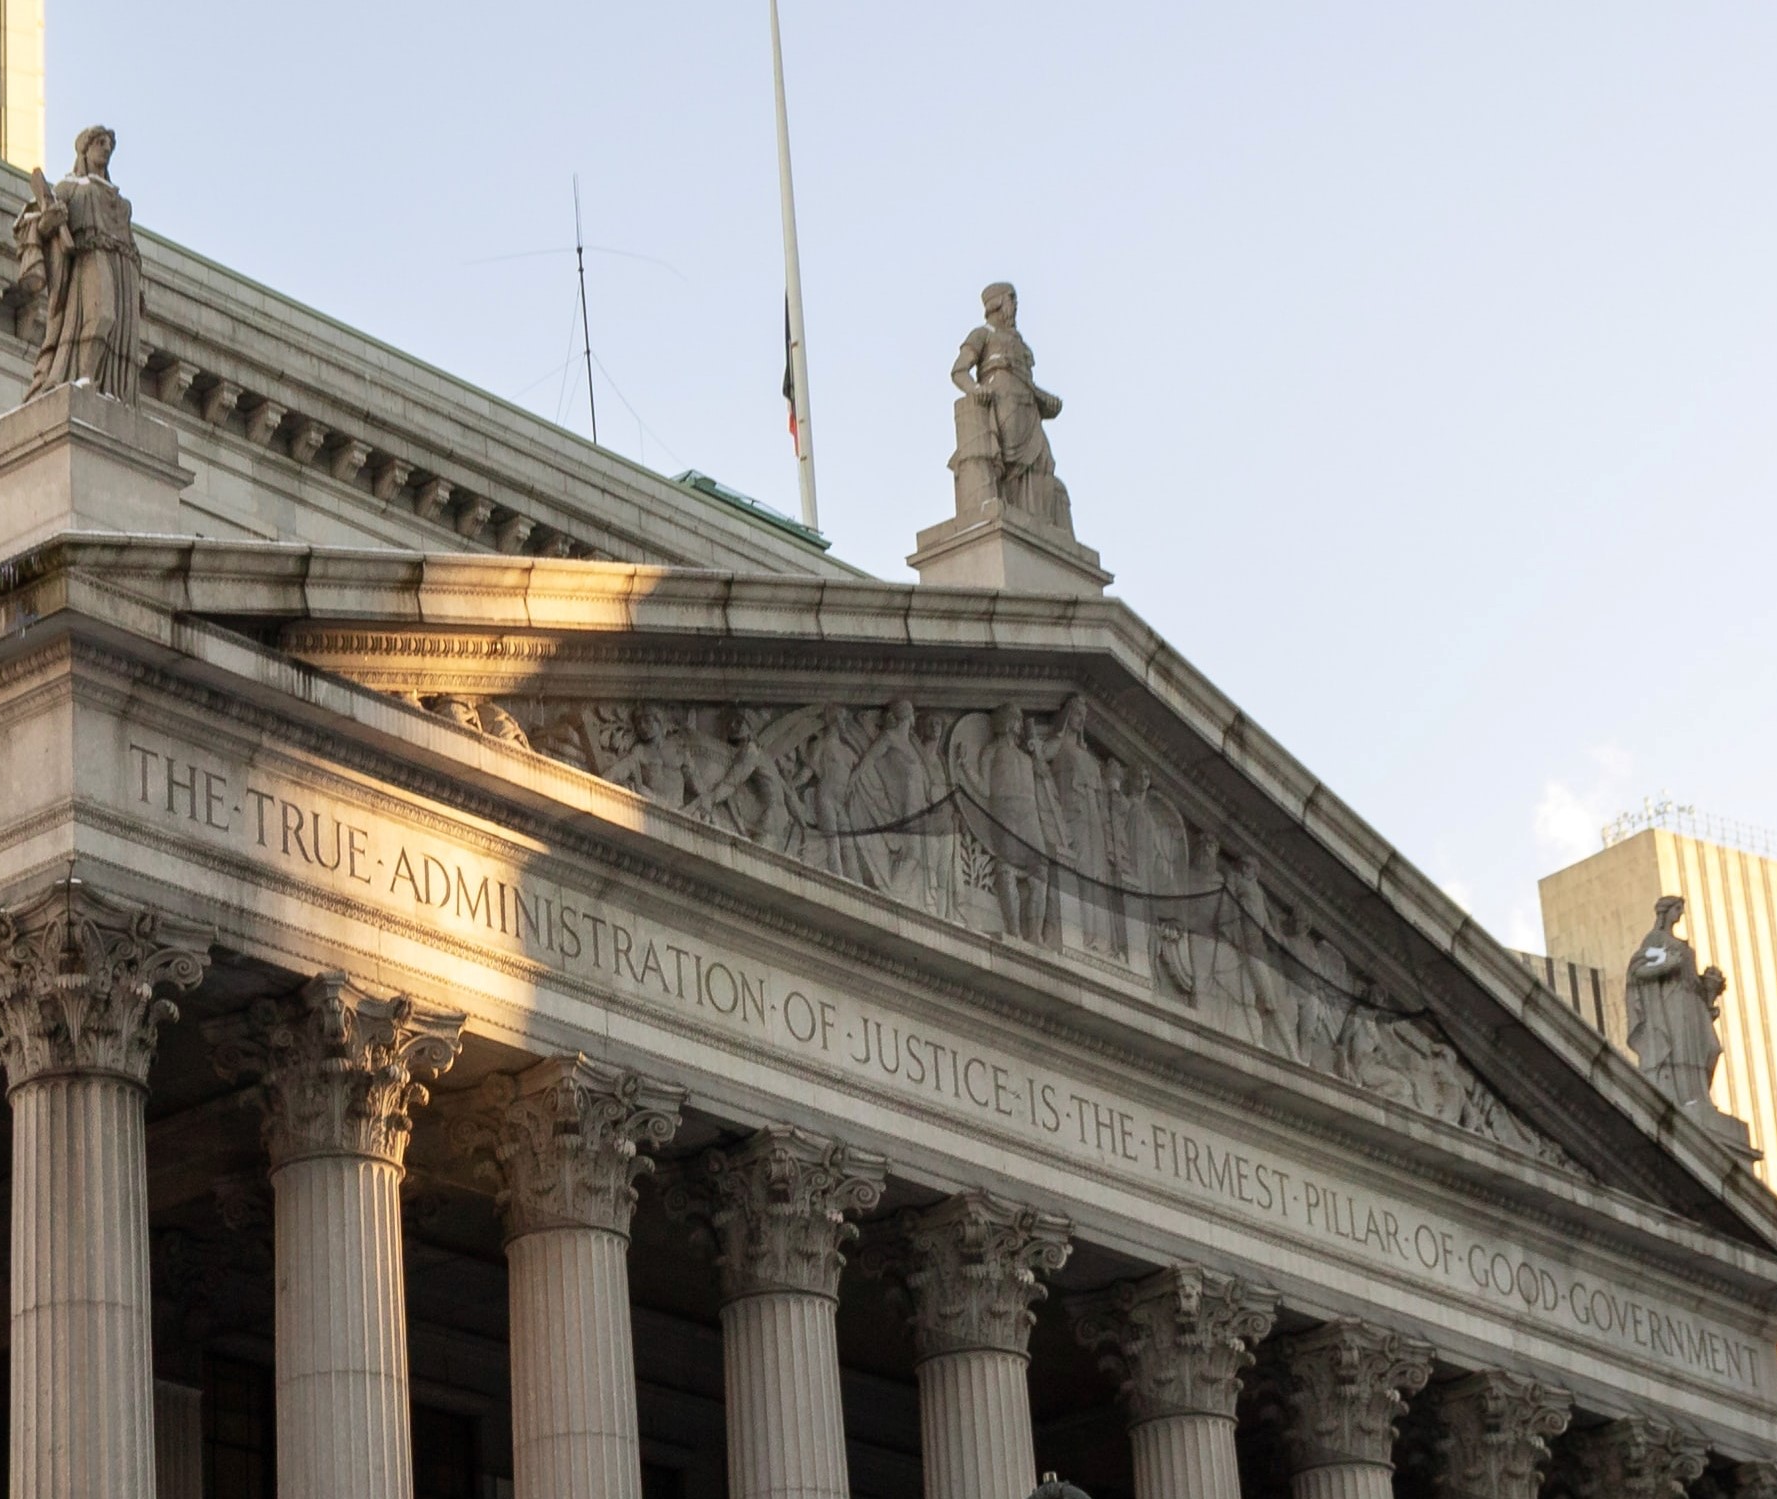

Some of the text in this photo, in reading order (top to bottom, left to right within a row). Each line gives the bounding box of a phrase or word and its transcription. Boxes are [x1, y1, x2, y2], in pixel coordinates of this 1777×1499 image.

[130, 743, 1758, 1389] THE TRUE ADMINISTRATION OF JUSTICE IS THE FIRMEST PILLAR OF GOOD GOVERNMENT
